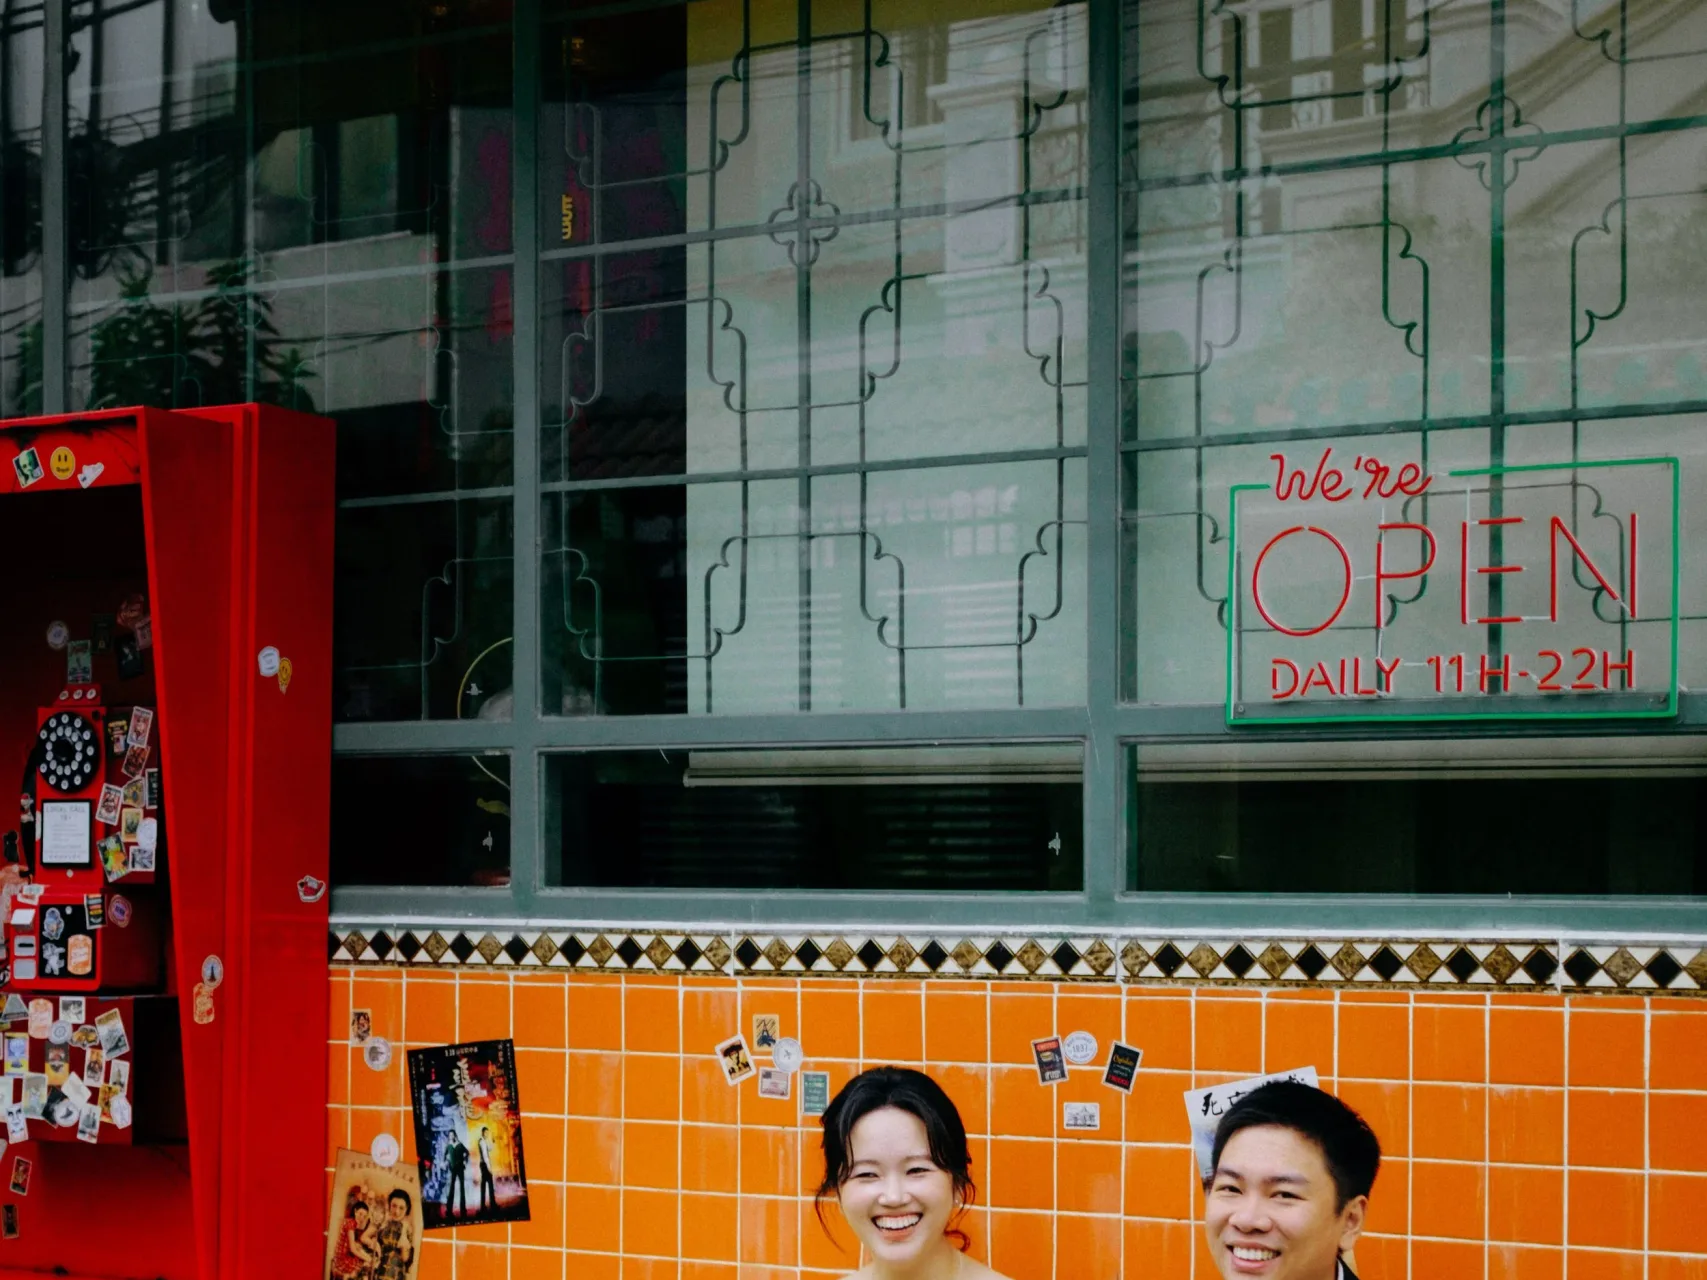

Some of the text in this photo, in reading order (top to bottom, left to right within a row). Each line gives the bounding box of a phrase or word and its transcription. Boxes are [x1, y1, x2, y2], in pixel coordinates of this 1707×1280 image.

[1270, 447, 1432, 502] We're
[1252, 513, 1638, 637] OPEN
[1271, 647, 1635, 699] DAILY 11H-22H
